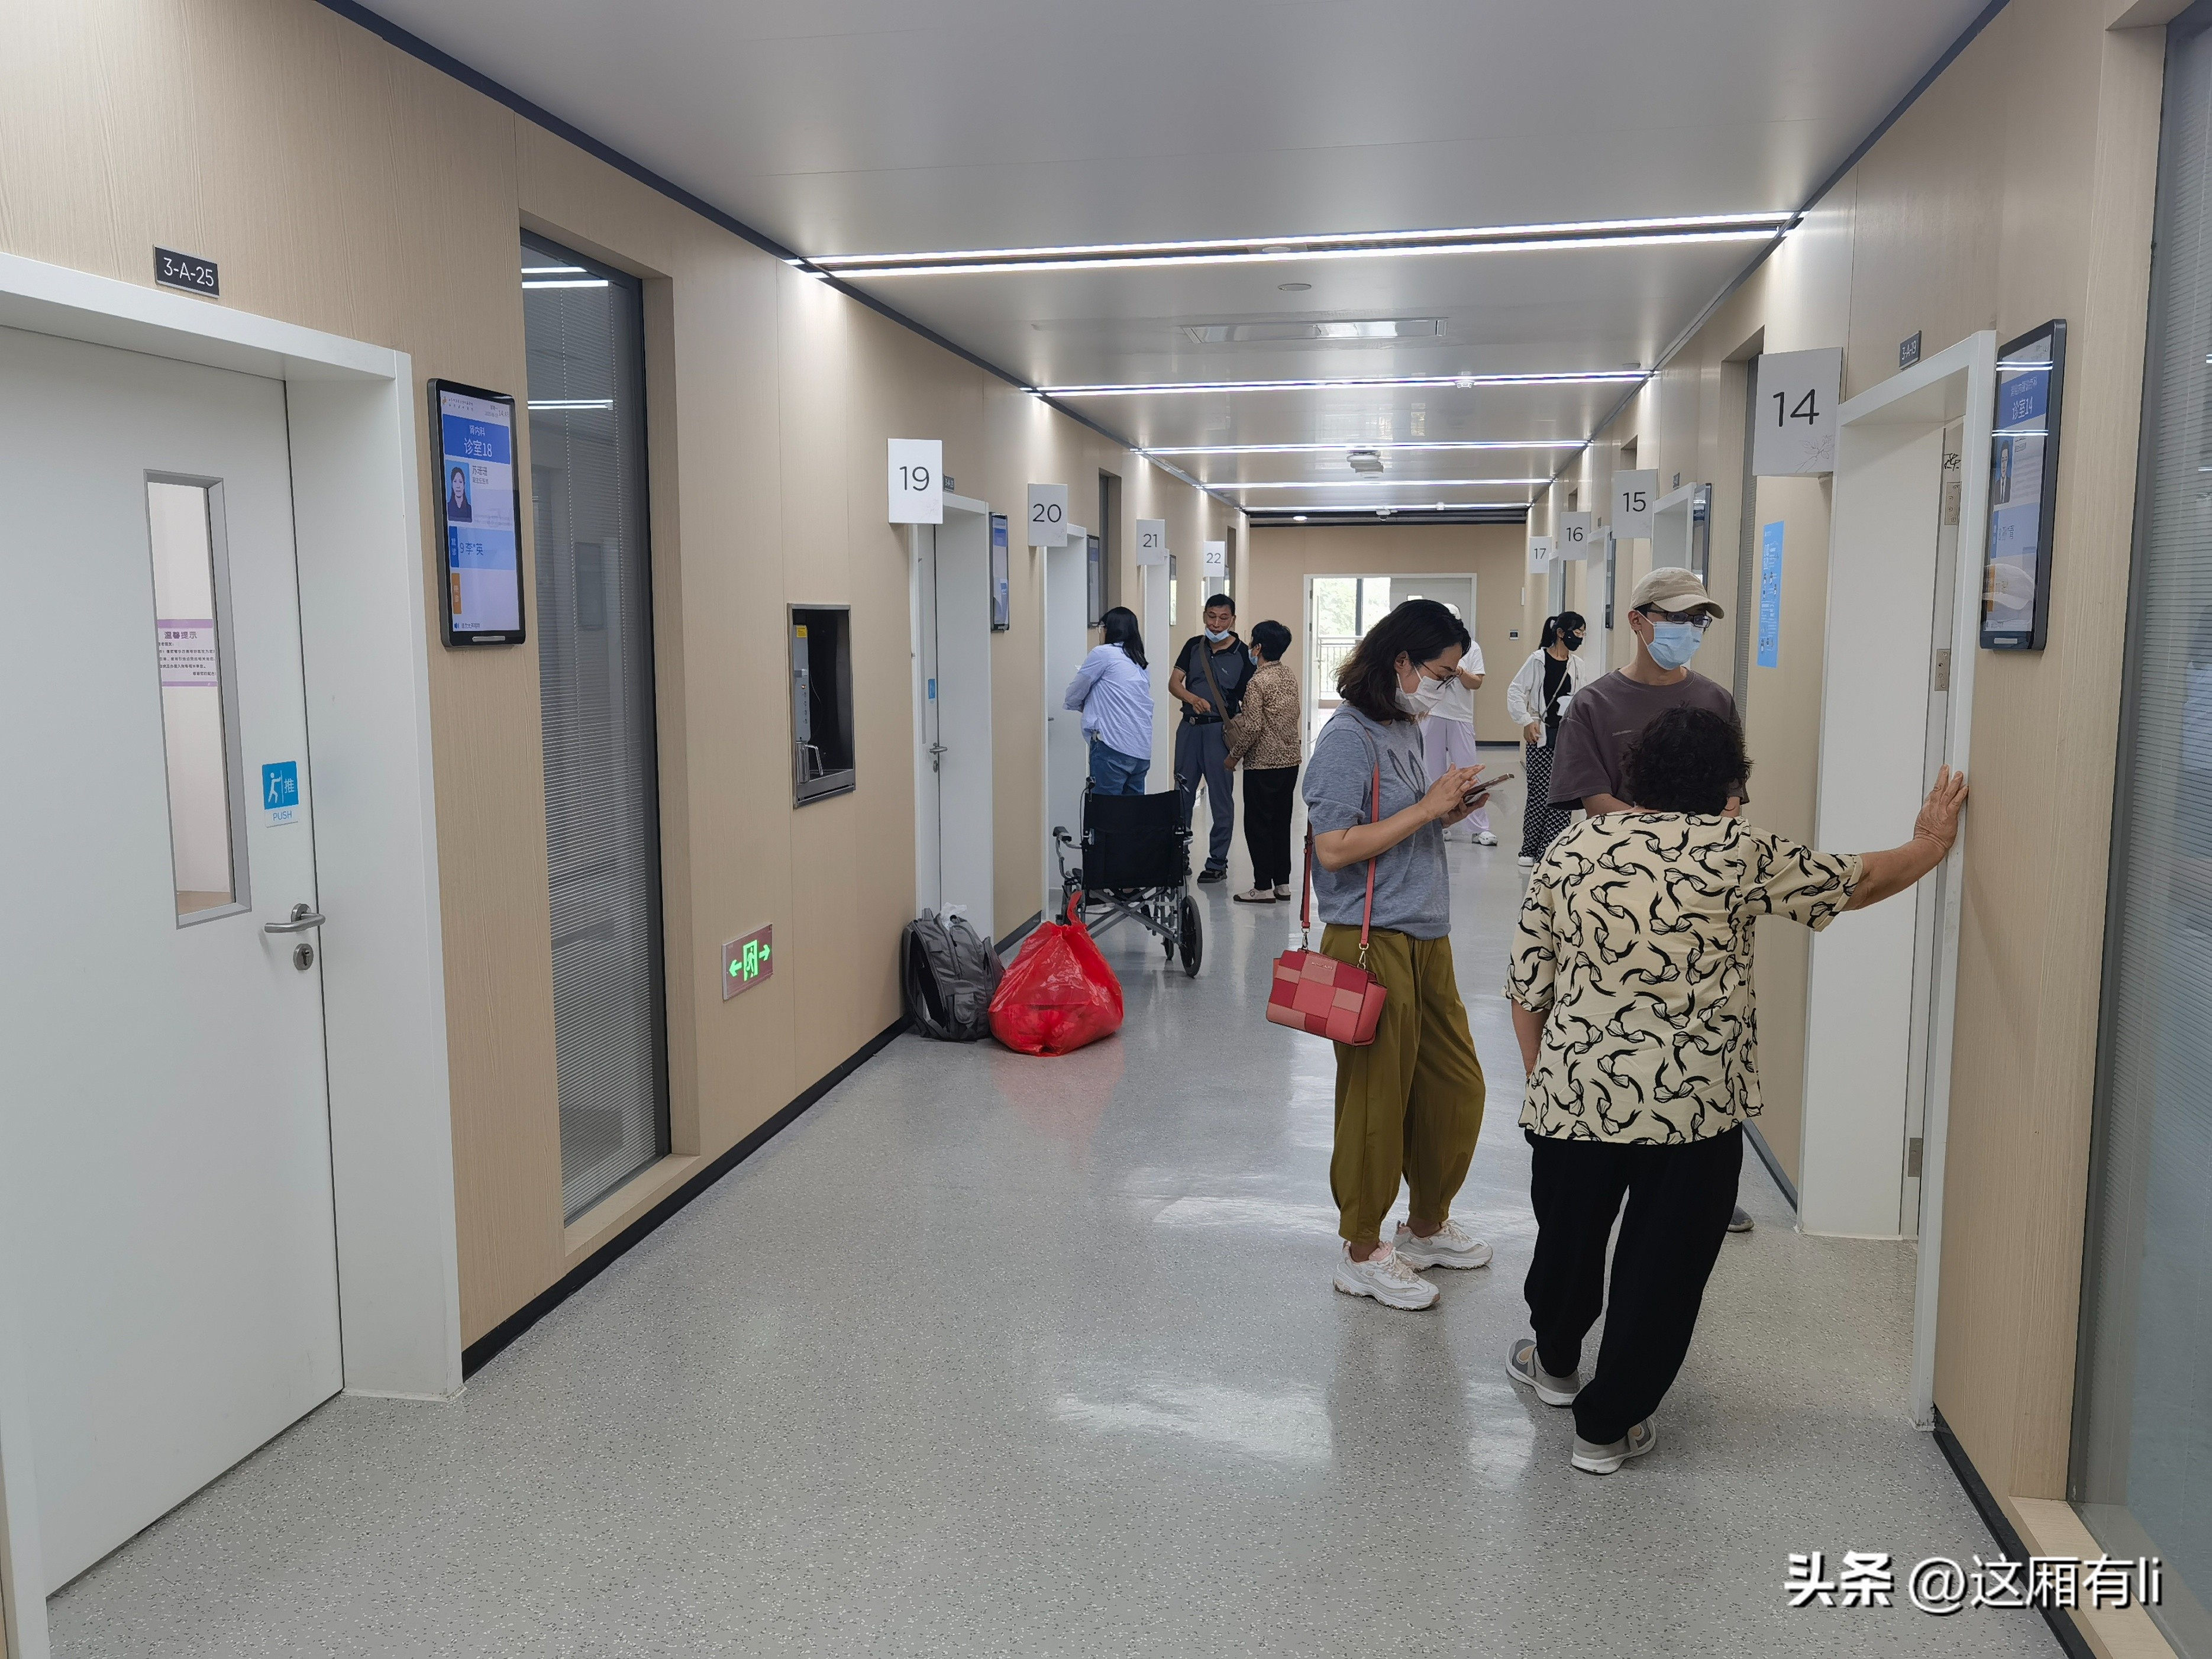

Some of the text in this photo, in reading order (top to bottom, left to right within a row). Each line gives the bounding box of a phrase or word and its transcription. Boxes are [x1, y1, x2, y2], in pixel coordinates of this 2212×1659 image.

[163, 257, 214, 286] 3-A-25
[1901, 340, 1917, 360] 3-A-19
[1772, 388, 1820, 427] 14
[2012, 396, 2033, 420] 诊室14
[464, 438, 492, 457] 诊室18
[899, 466, 930, 492] 19
[1623, 492, 1646, 512] 15
[1032, 503, 1062, 523] 20
[1143, 534, 1158, 548] 21
[1566, 527, 1584, 542] 16
[1206, 553, 1222, 564] 22
[1533, 548, 1546, 560] 17
[284, 778, 295, 793] 推
[273, 811, 292, 821] PUSH
